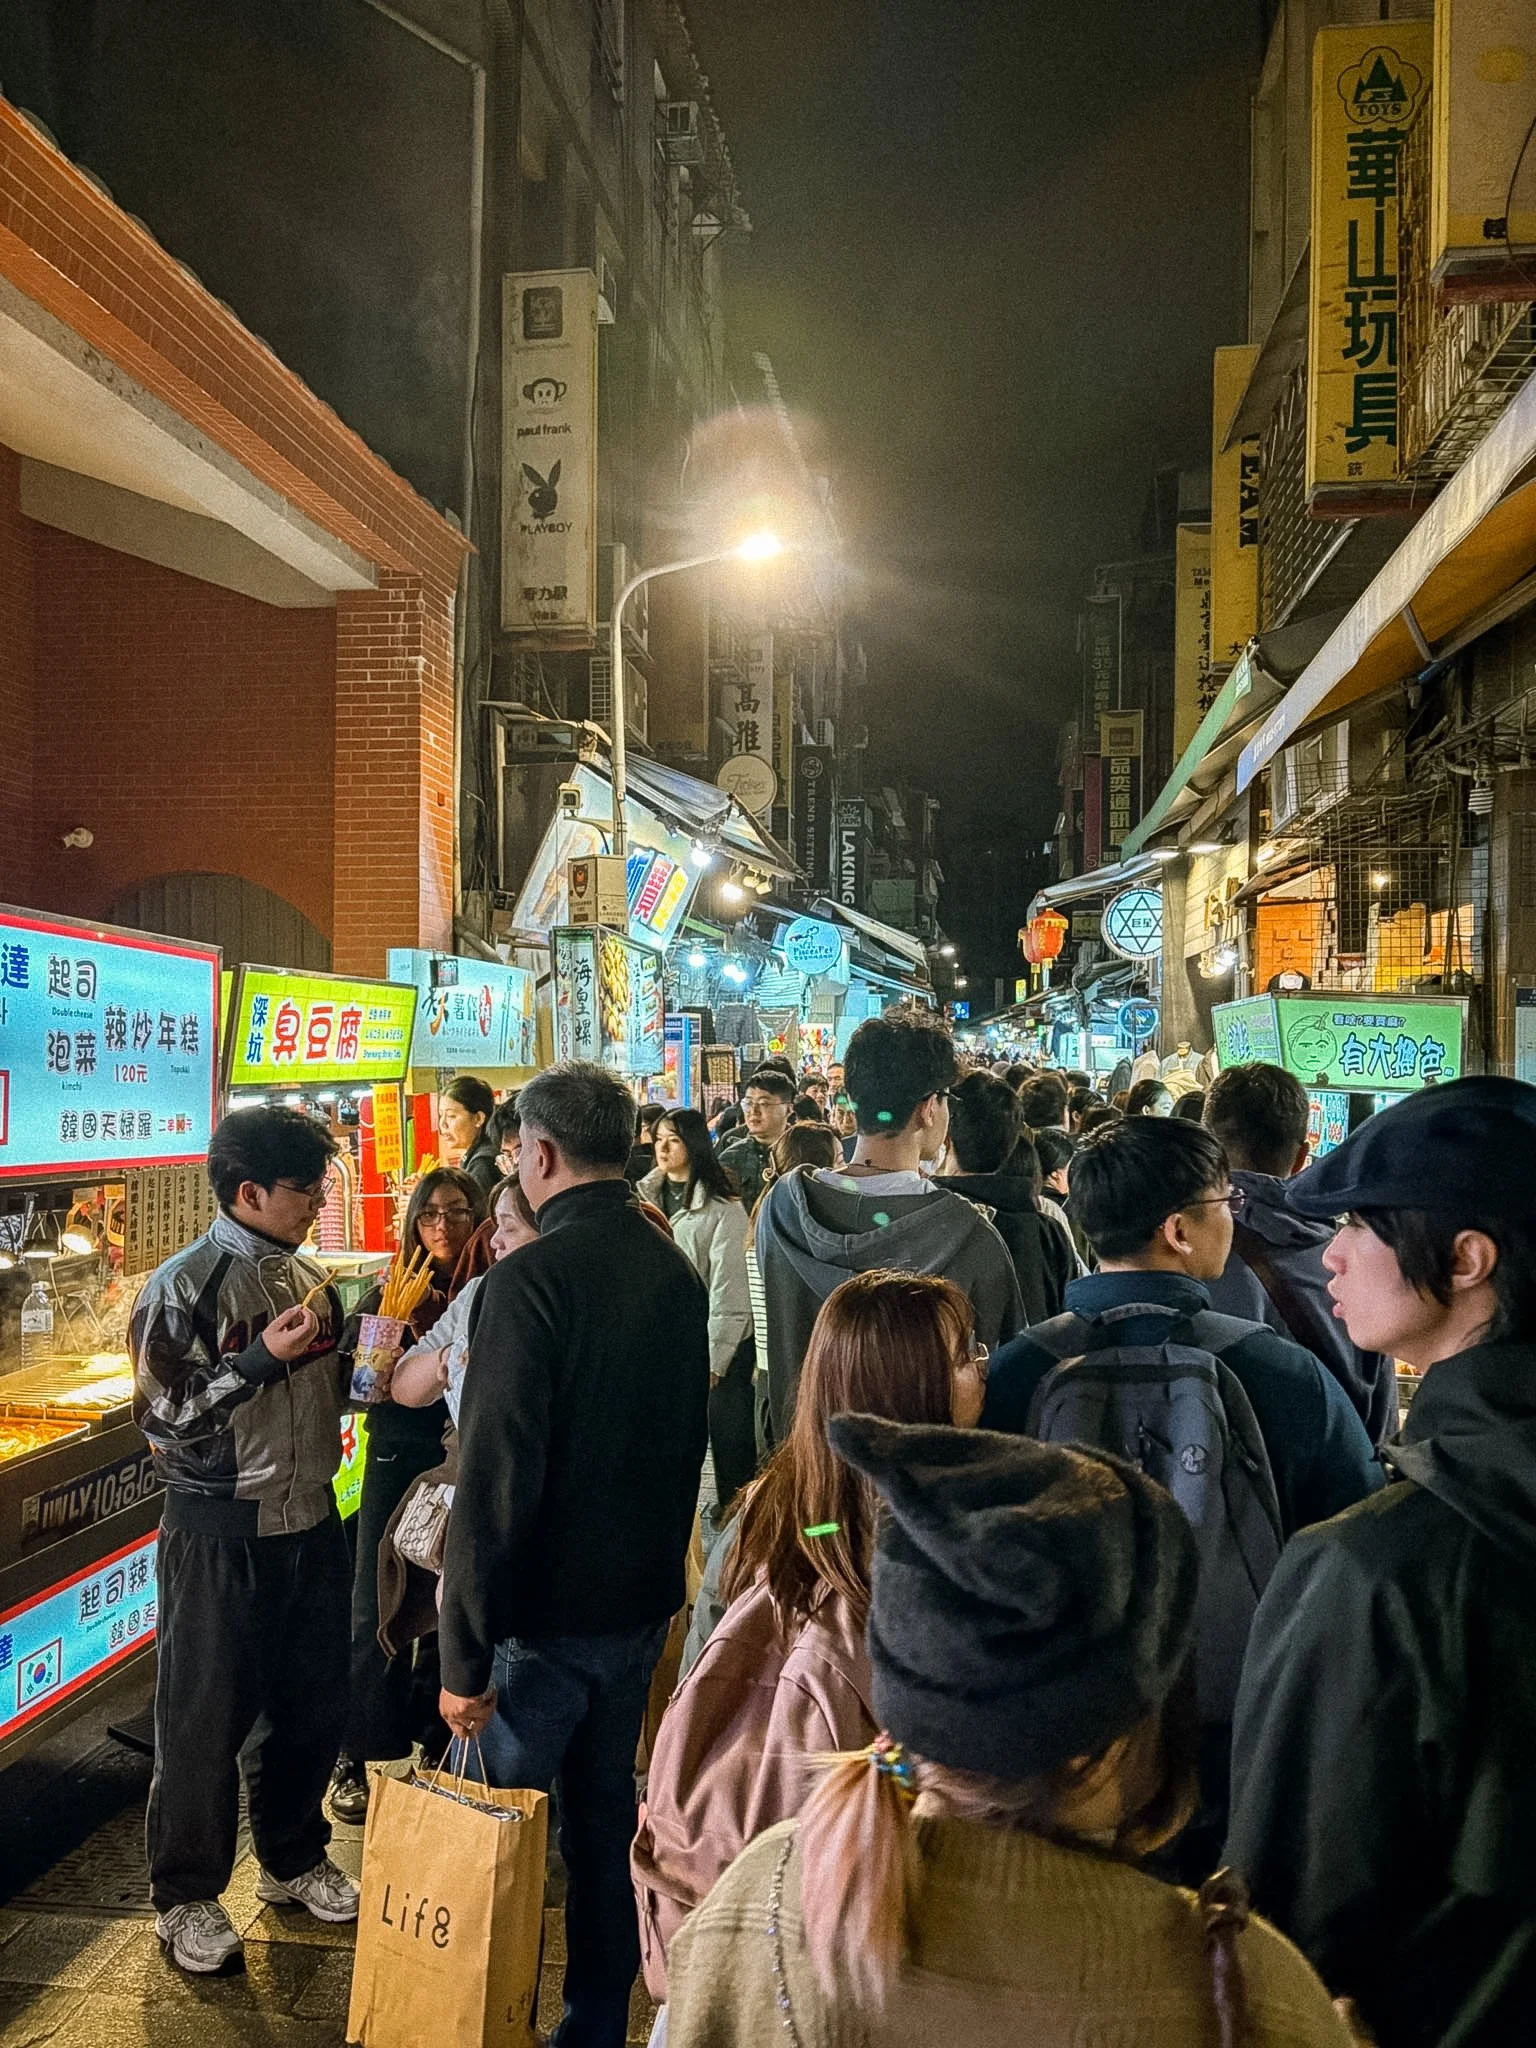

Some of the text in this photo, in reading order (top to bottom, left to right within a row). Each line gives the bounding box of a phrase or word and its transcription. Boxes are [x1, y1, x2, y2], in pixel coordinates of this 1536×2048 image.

[1357, 104, 1401, 117] TOYS
[1344, 127, 1407, 454] 華山玩具
[542, 423, 572, 435] frank
[520, 521, 573, 535] PLAYBOY
[841, 830, 856, 904] LAKING
[49, 954, 97, 1001] 起司
[48, 1030, 97, 1075] 泡菜
[104, 1004, 200, 1054] 辣炒年糕
[246, 996, 269, 1064] 深坑
[272, 1002, 363, 1061] 臭豆腐
[115, 1063, 149, 1084] 120元
[79, 1554, 158, 1625] 起司辣
